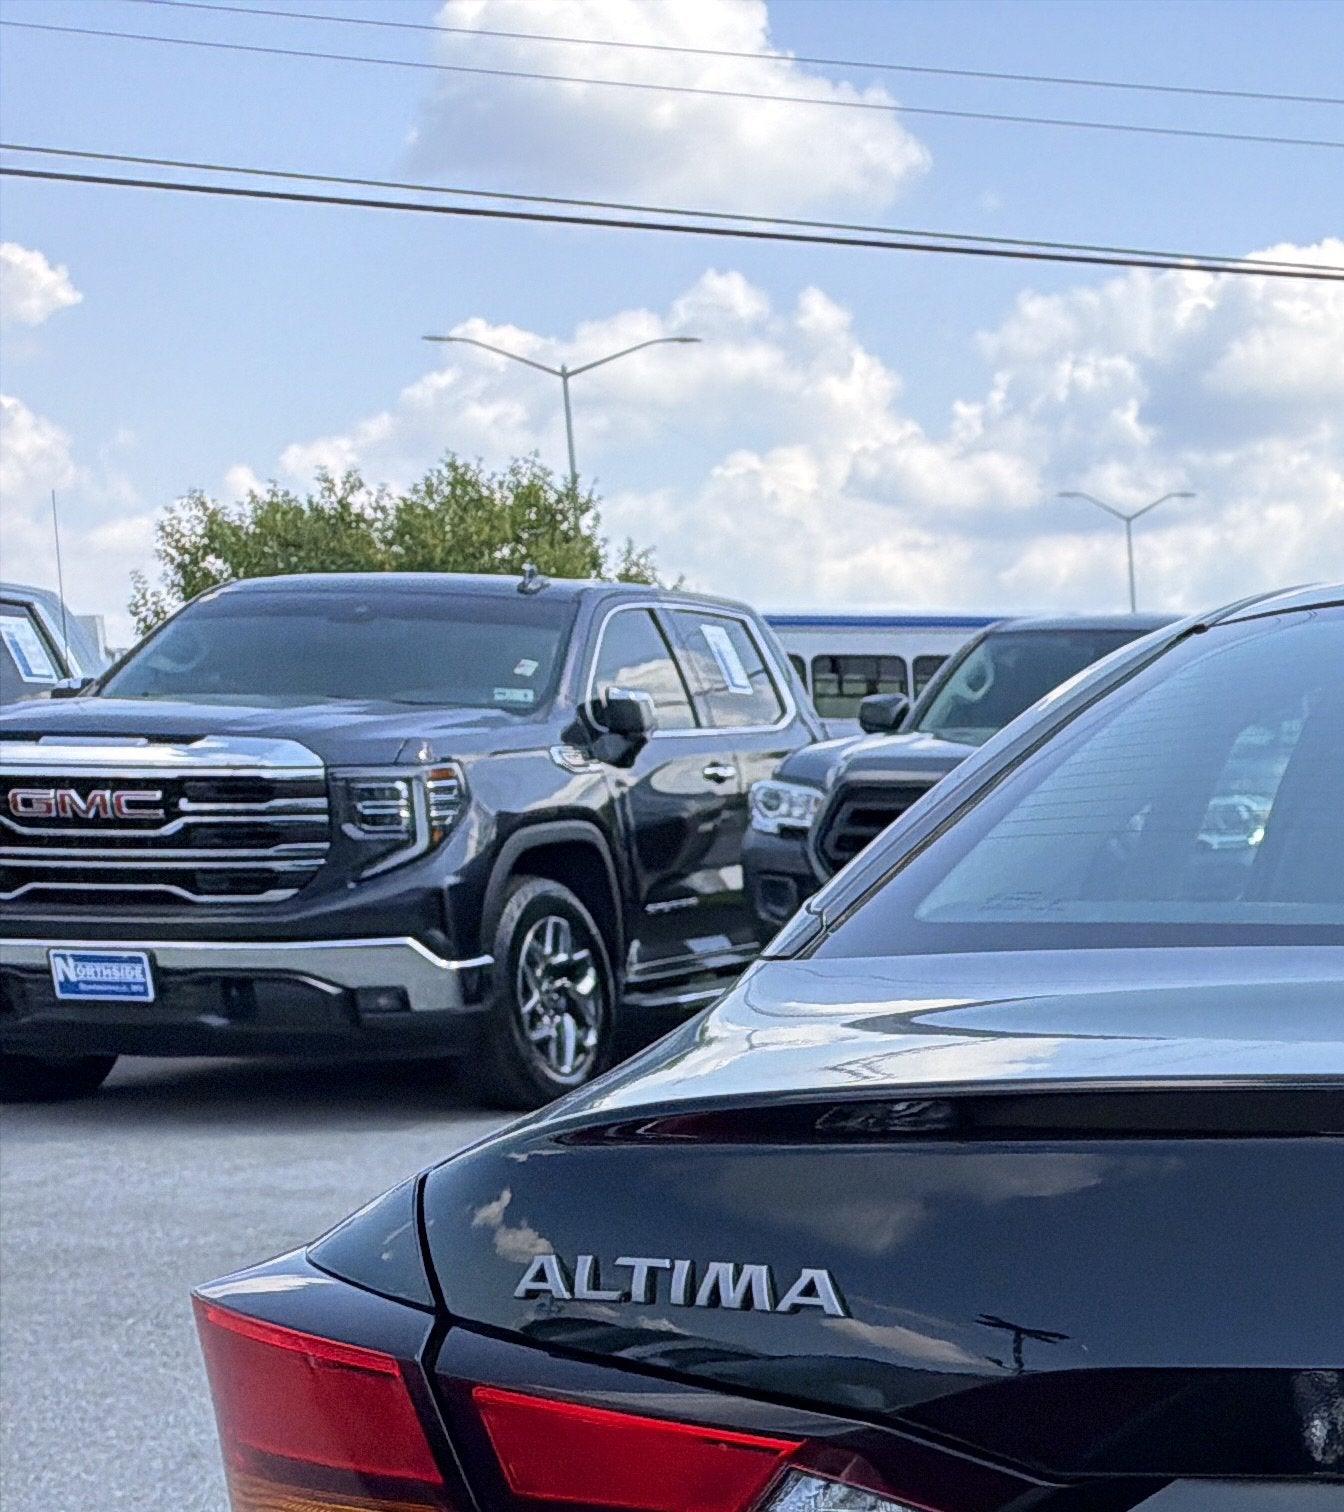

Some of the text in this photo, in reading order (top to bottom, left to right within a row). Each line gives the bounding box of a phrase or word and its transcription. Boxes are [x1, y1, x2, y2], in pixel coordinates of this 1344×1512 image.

[8, 788, 165, 819] GMC
[54, 955, 145, 982] NORTHSIDE
[513, 1254, 851, 1318] ALTIMA
